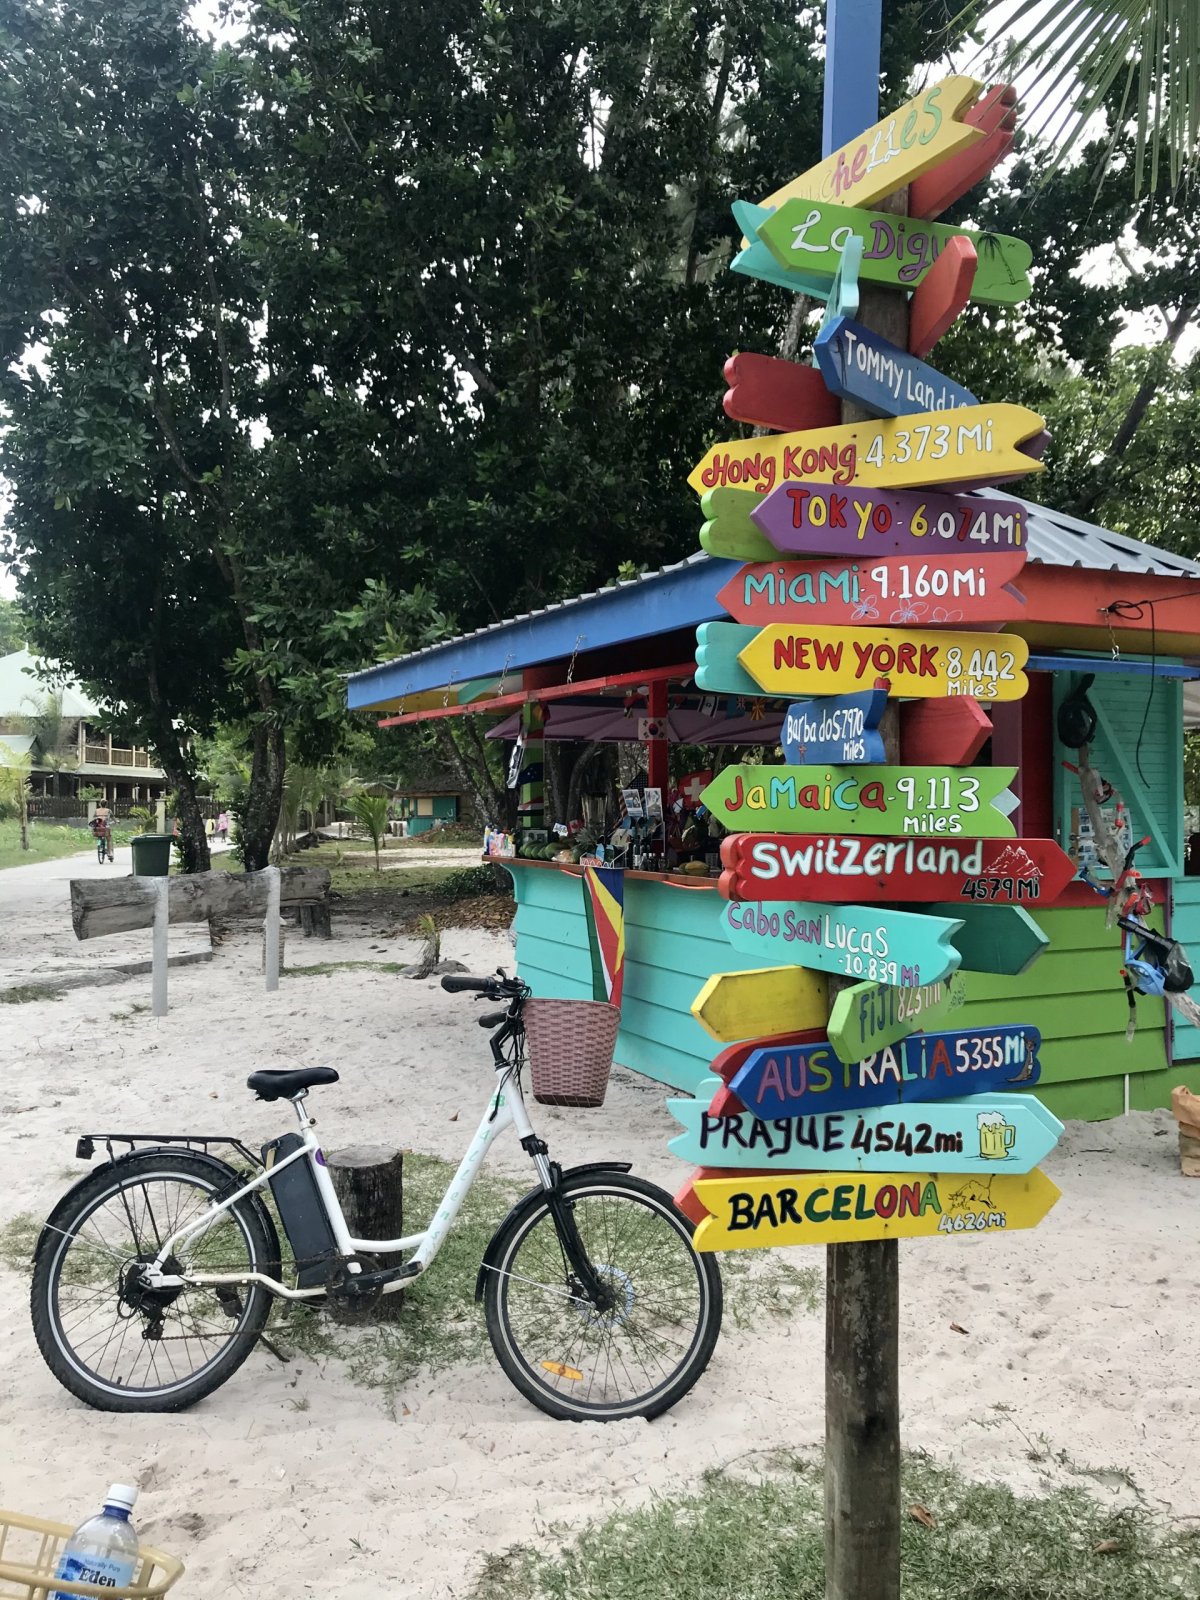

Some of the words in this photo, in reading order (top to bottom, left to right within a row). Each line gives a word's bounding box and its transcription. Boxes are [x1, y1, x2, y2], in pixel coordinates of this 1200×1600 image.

[863, 219, 950, 282] Digu
[773, 635, 844, 671] NEW
[852, 642, 939, 679] YORK
[727, 1181, 942, 1231] BARCELONA
[79, 1567, 117, 1588] Eden
